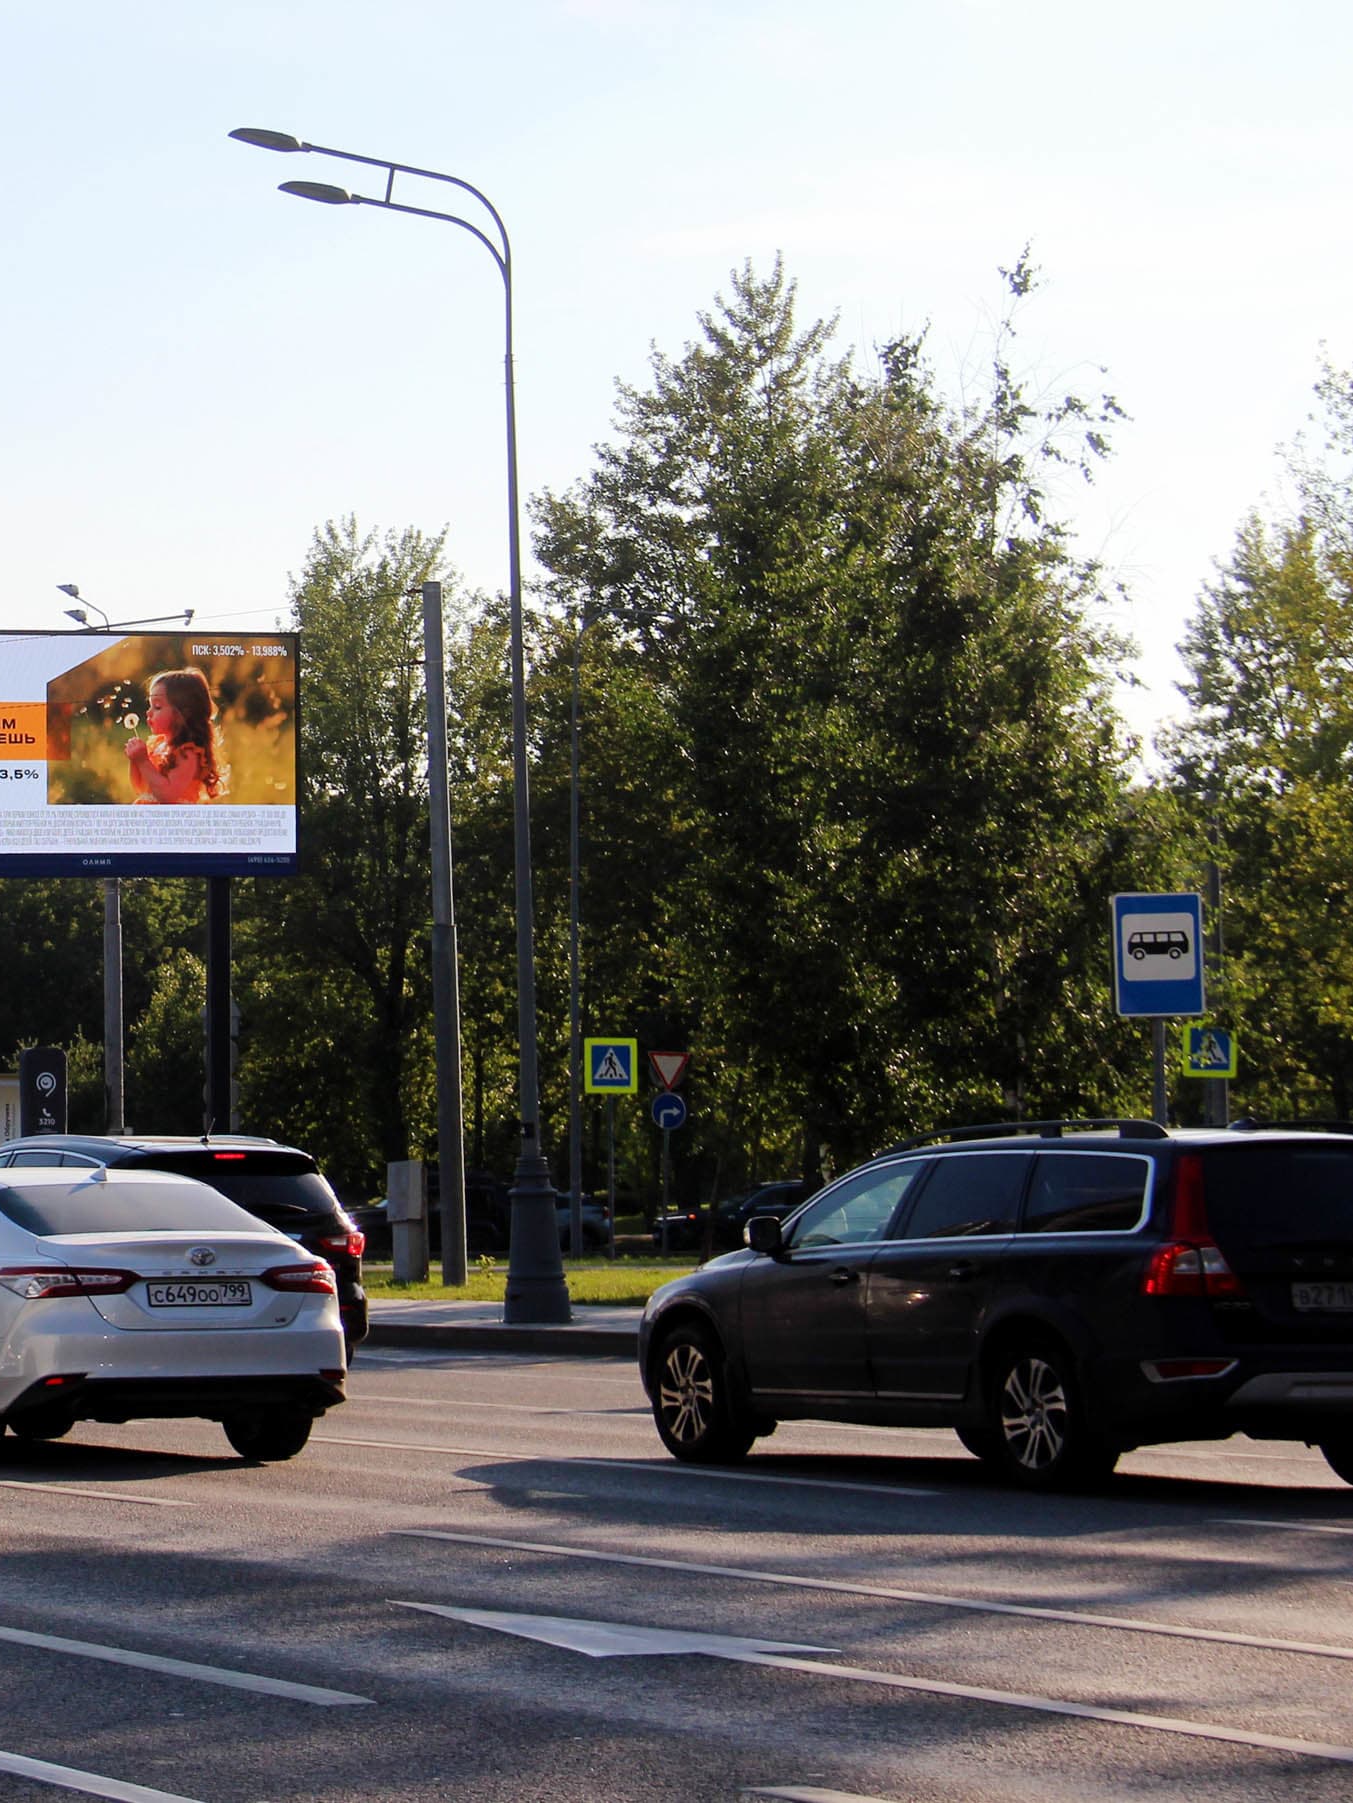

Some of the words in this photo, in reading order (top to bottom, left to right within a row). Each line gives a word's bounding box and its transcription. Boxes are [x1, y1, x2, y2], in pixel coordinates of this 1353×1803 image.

[192, 644, 211, 656] ПСК:
[212, 645, 245, 656] 3,502%
[251, 645, 288, 657] 13,988%
[0, 769, 39, 780] 3,5%
